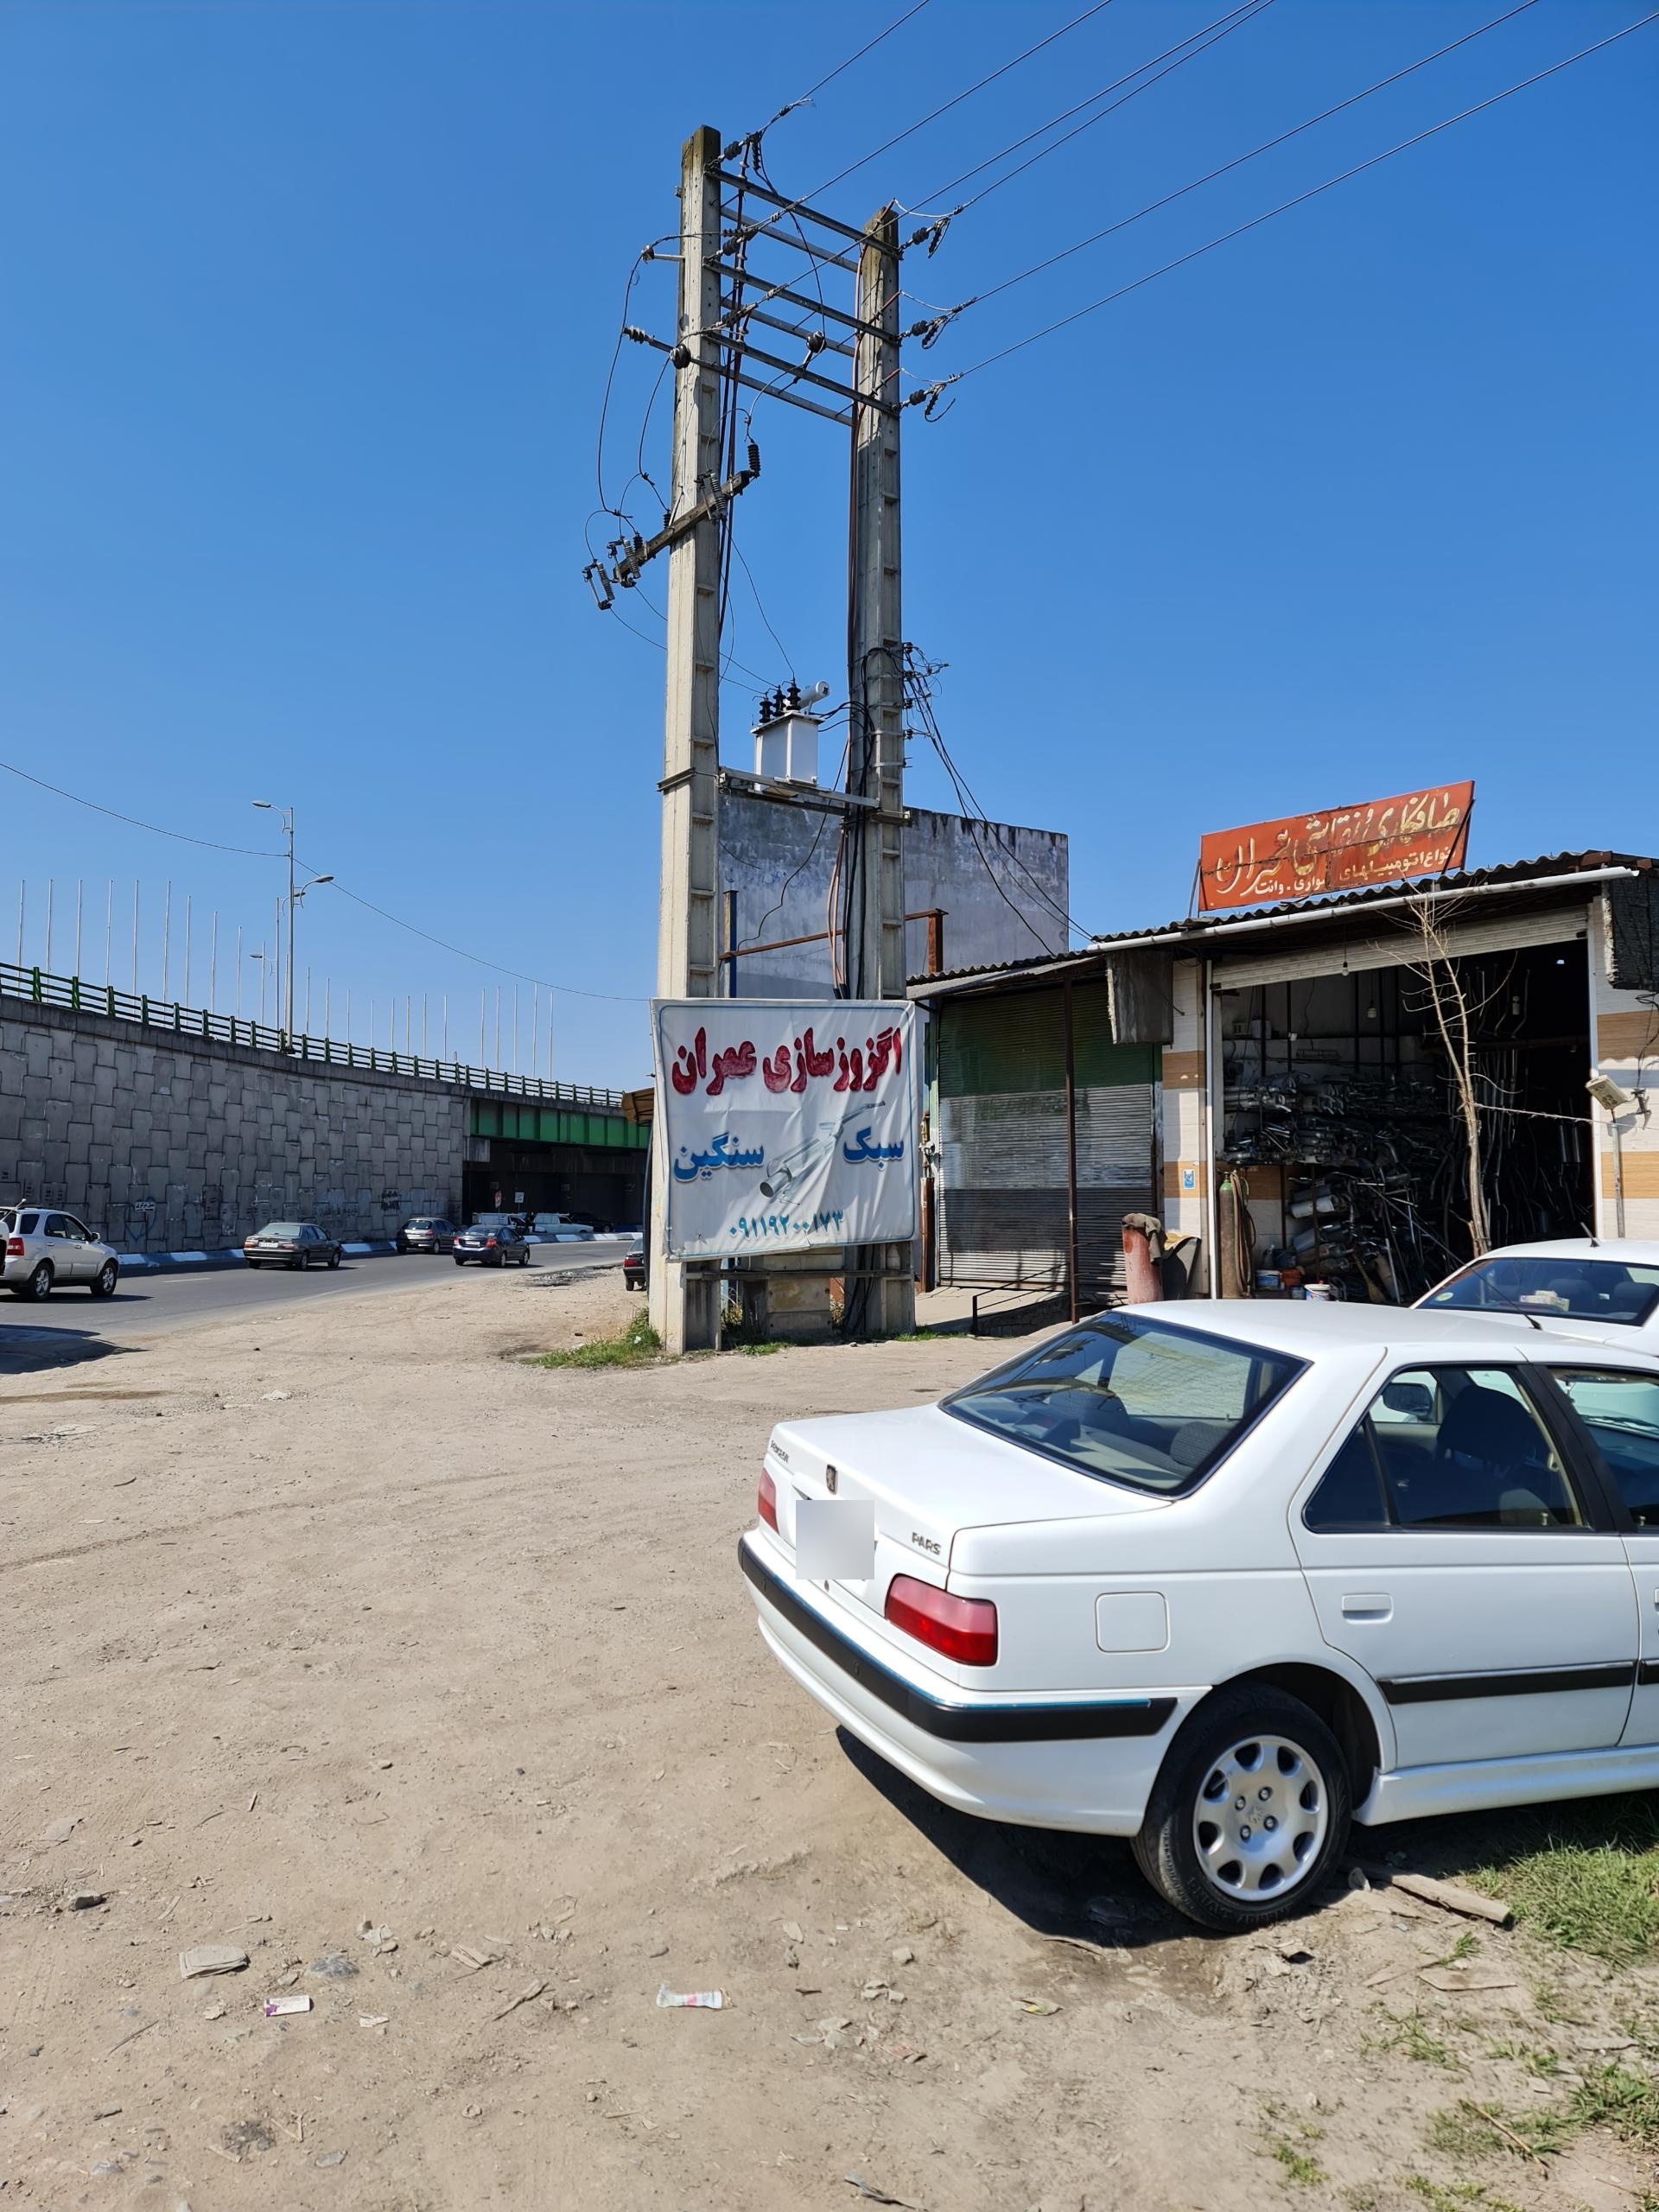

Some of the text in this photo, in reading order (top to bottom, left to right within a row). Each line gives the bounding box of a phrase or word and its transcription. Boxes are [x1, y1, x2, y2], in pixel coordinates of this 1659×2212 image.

[1255, 879, 1284, 894] وانت
[672, 1027, 757, 1096] عمران
[674, 1127, 905, 1181] سبک سنگین
[912, 1531, 941, 1555] PARS
